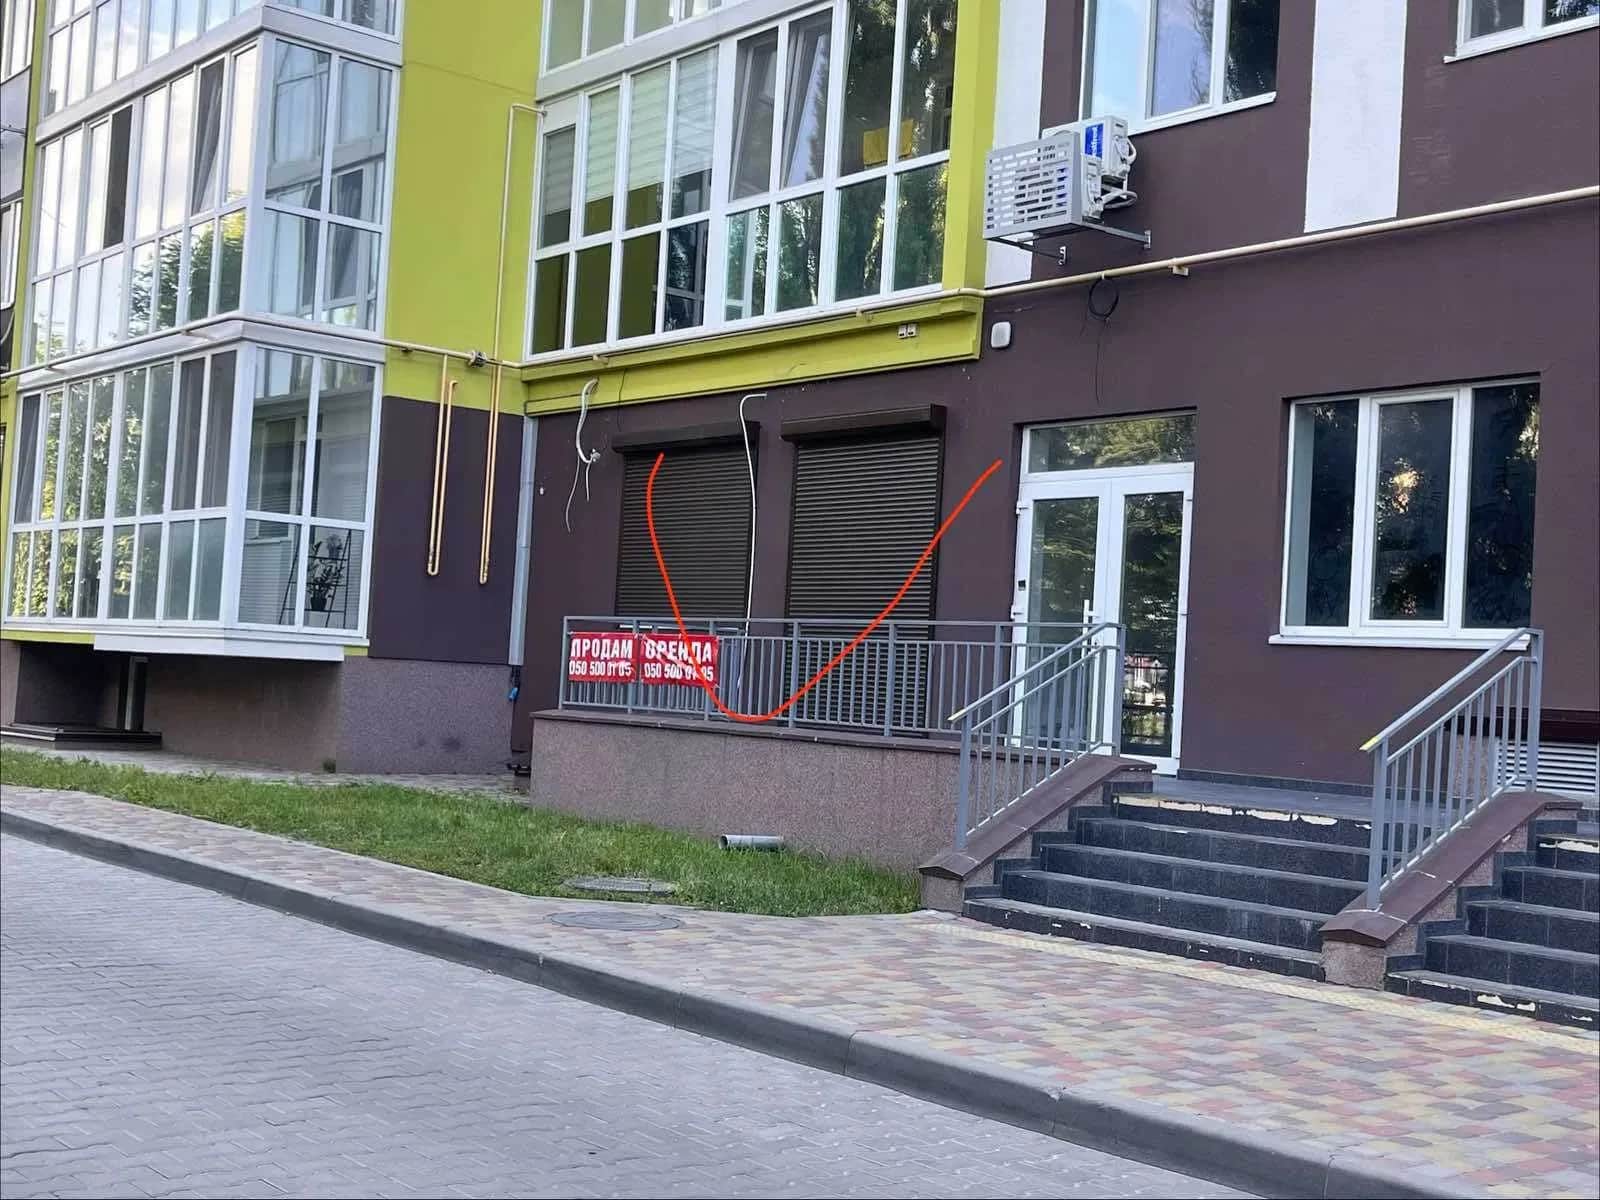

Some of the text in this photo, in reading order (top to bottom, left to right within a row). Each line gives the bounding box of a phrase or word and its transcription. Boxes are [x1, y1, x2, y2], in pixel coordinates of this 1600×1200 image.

[570, 638, 633, 660] ПРОДАМ
[569, 660, 588, 676] 050
[589, 661, 606, 676] 500
[618, 662, 632, 677] 05
[644, 662, 662, 678] 050
[664, 663, 683, 680] 500
